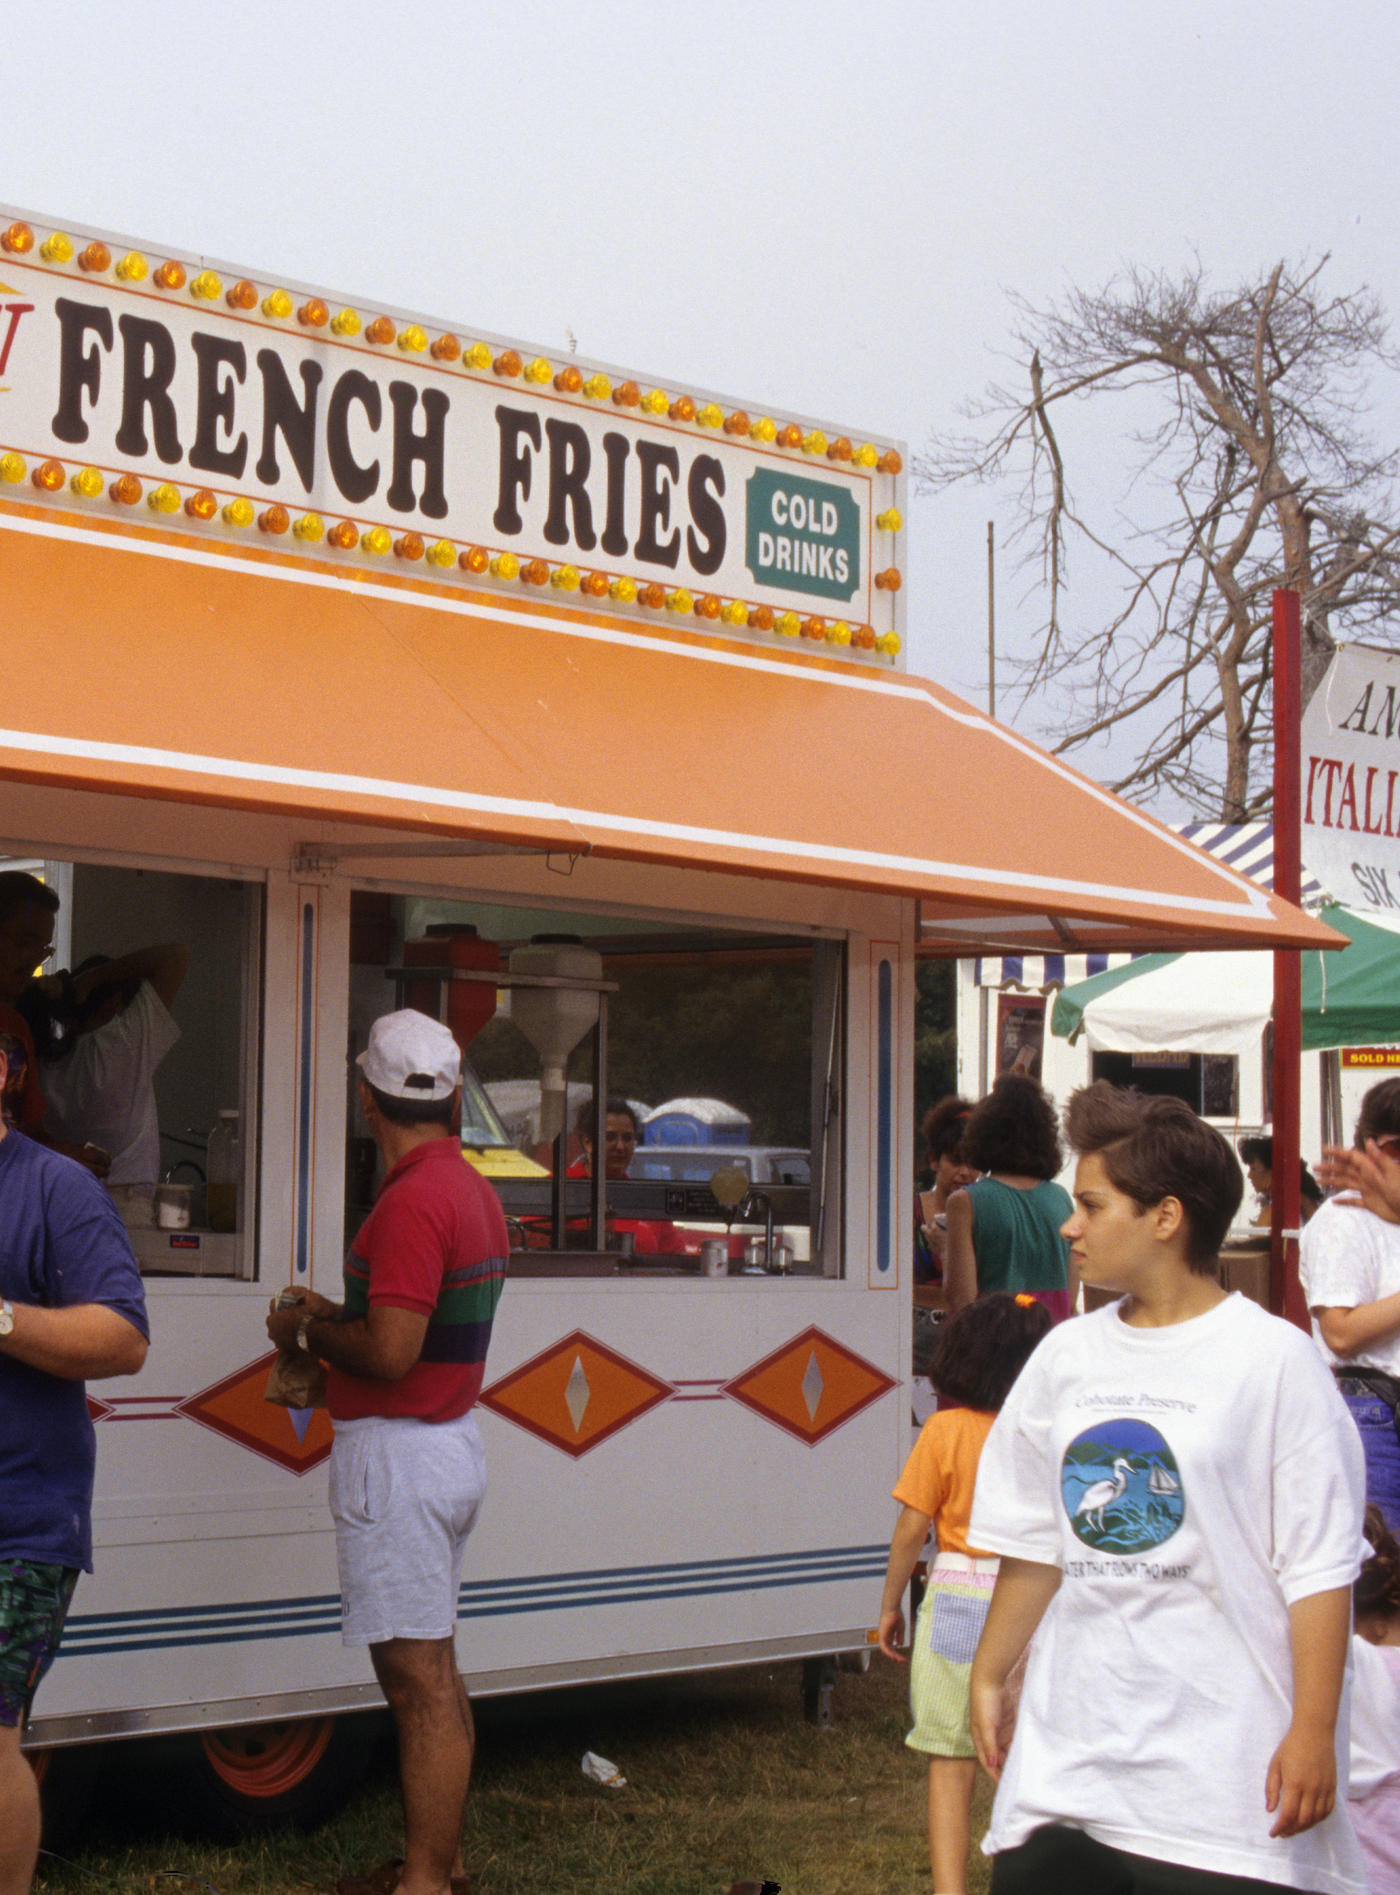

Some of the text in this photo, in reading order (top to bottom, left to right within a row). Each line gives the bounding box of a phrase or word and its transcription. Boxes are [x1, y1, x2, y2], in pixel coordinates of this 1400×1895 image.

[52, 297, 726, 575] FRENCH FRIES
[771, 489, 839, 535] COLD
[758, 531, 852, 584] DRINKS
[1350, 1053, 1384, 1064] SOLD
